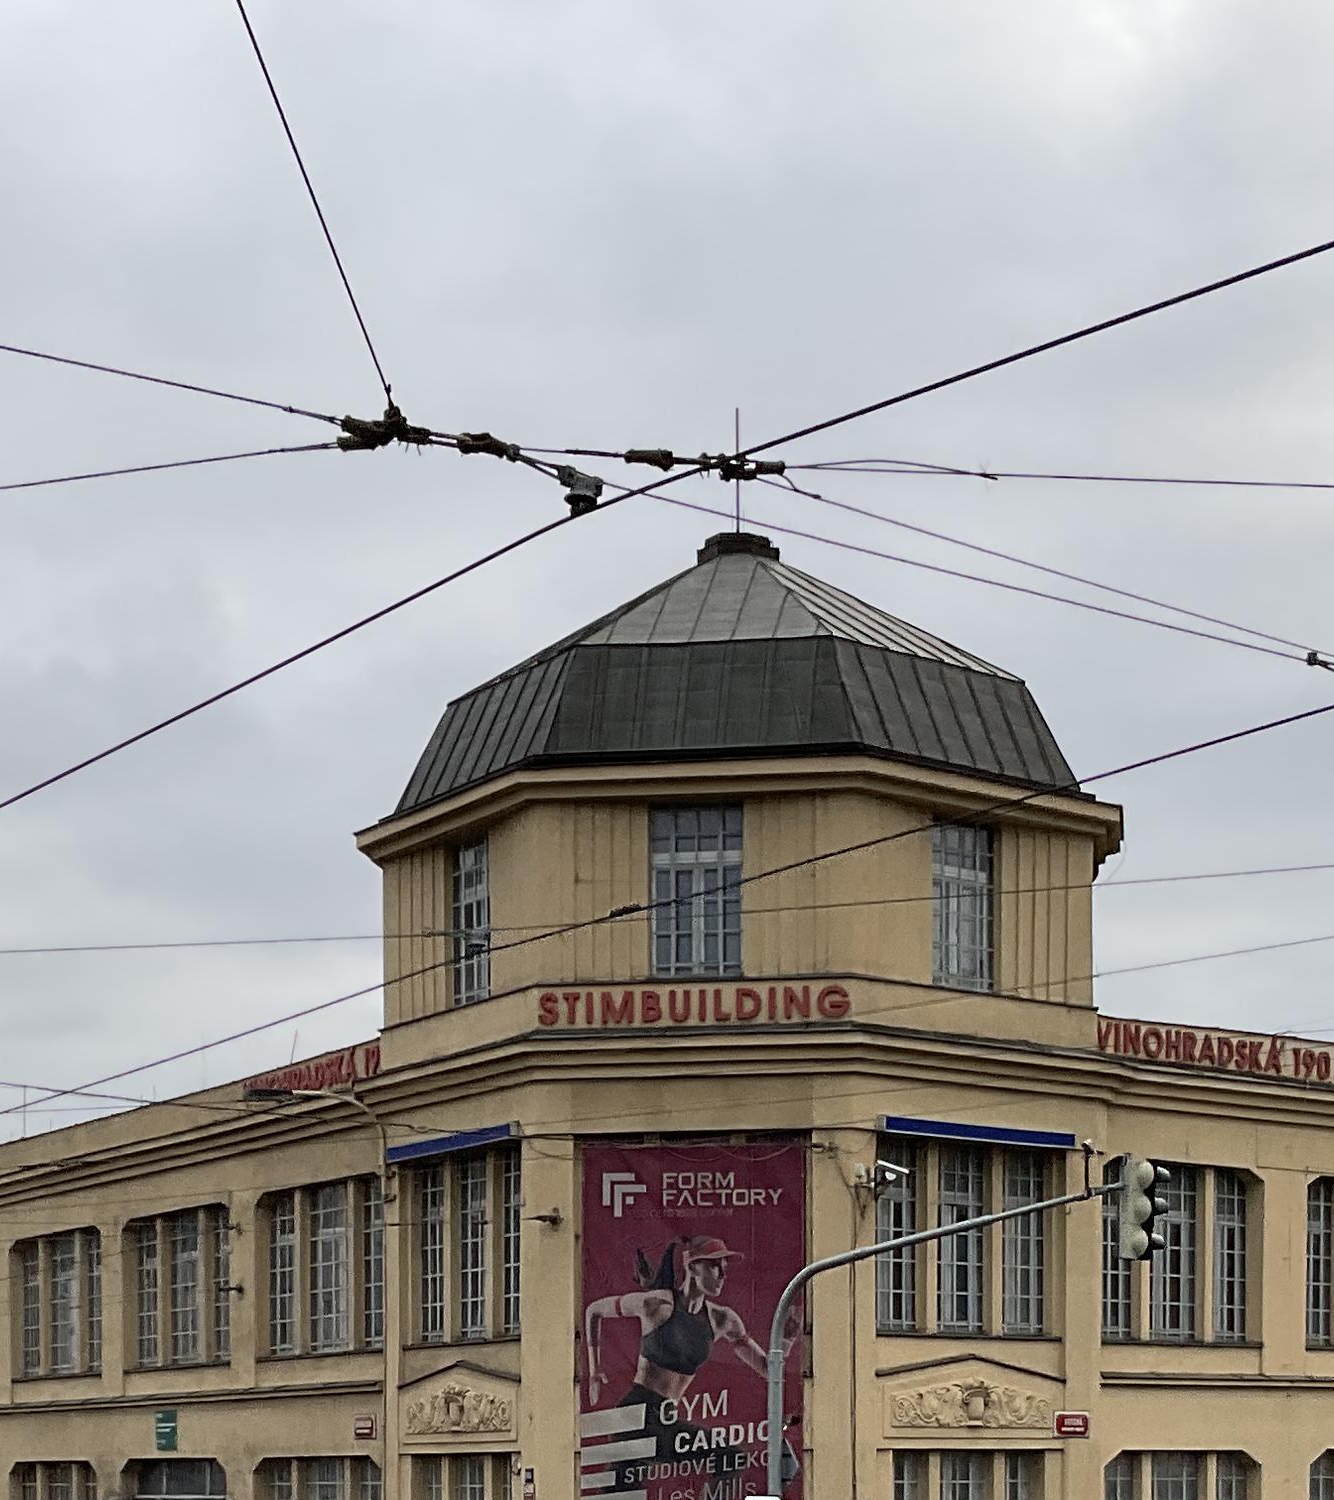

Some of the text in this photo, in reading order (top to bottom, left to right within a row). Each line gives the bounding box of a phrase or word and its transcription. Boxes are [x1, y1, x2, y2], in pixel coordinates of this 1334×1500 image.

[538, 984, 852, 1027] STIMBUILDING
[1096, 1019, 1331, 1081] VINOHRADSKÁ 190
[662, 1171, 735, 1189] FORM
[662, 1188, 783, 1207] FACTORY
[659, 1389, 729, 1426] GYM
[623, 1453, 717, 1484] STUDIOVÉ
